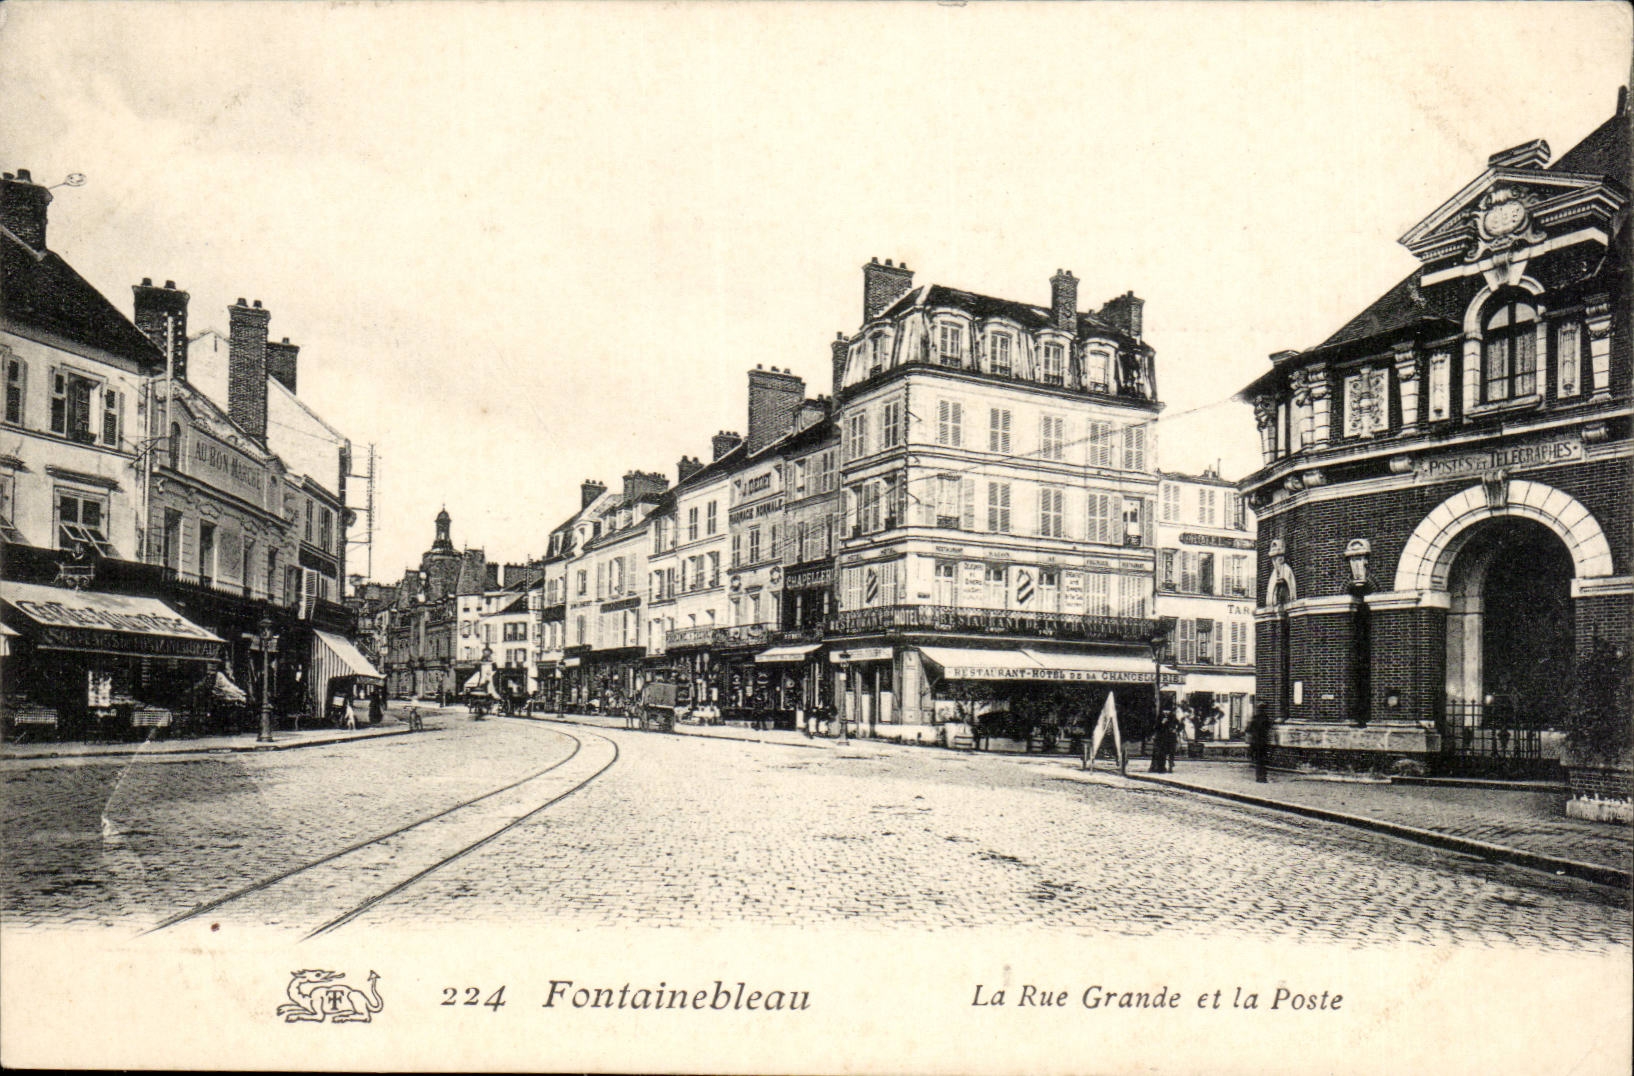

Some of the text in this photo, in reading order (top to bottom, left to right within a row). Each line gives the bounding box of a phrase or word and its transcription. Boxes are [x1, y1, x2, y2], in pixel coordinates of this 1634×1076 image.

[210, 446, 229, 473] BON
[1430, 456, 1473, 474] POSTES
[787, 567, 837, 587] CHAPELLERI
[893, 608, 919, 626] HOTEL
[939, 614, 1018, 629] RESTAURANT
[954, 668, 1065, 680] RESTAURANT-HOTEL
[1070, 672, 1082, 680] DE
[1102, 671, 1180, 683] CHANCELLRIE
